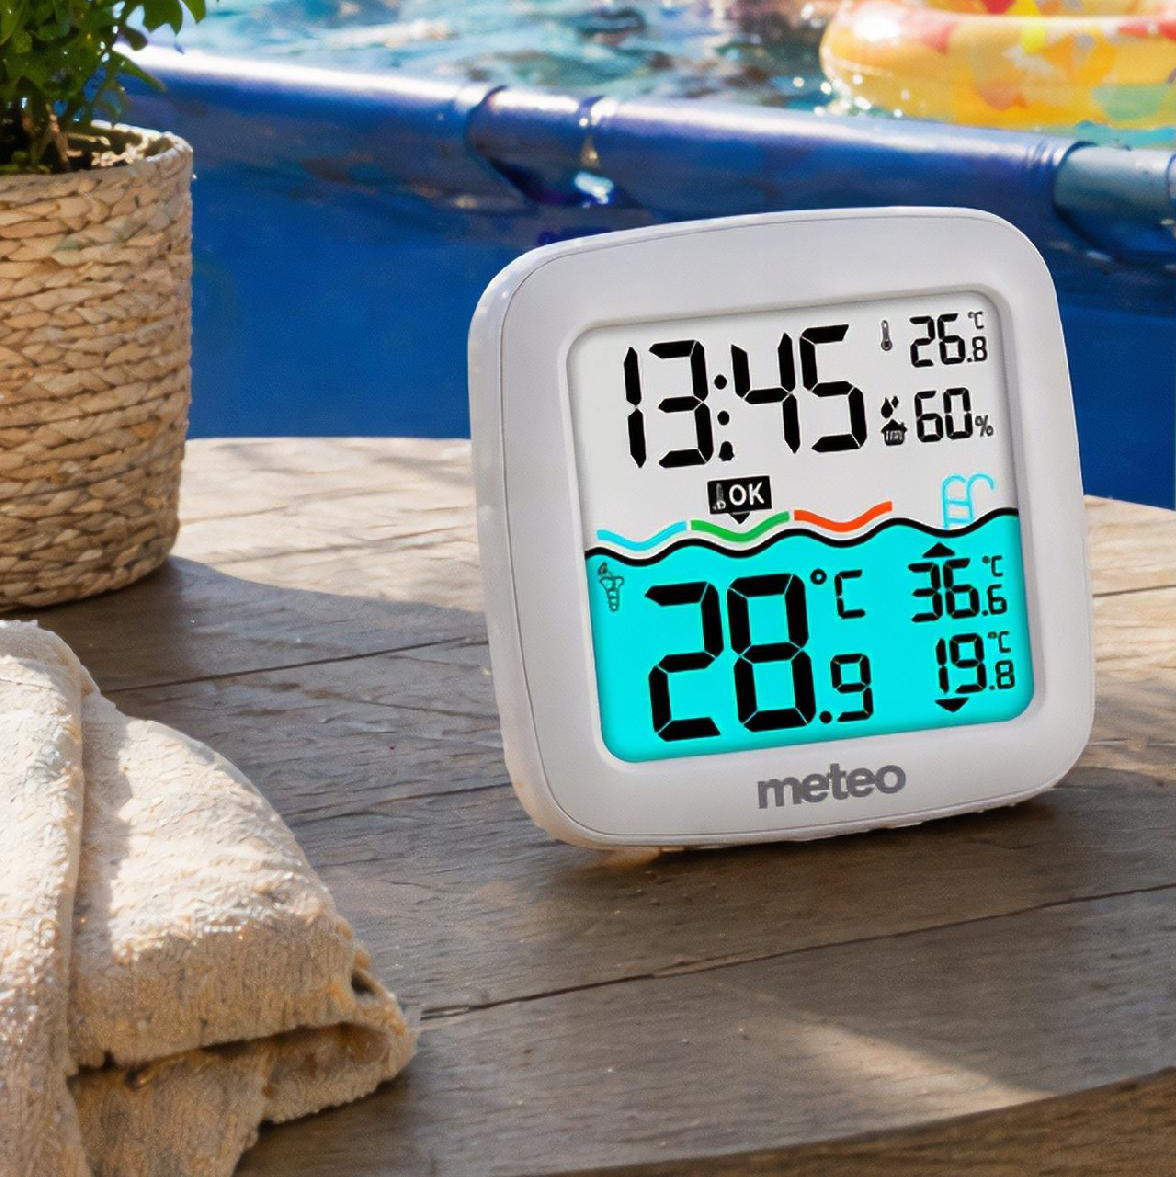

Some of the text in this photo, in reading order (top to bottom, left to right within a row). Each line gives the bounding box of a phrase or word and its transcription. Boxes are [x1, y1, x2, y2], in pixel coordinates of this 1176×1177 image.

[623, 324, 868, 469] 13:45
[729, 482, 765, 507] OK
[757, 763, 907, 809] meteo
